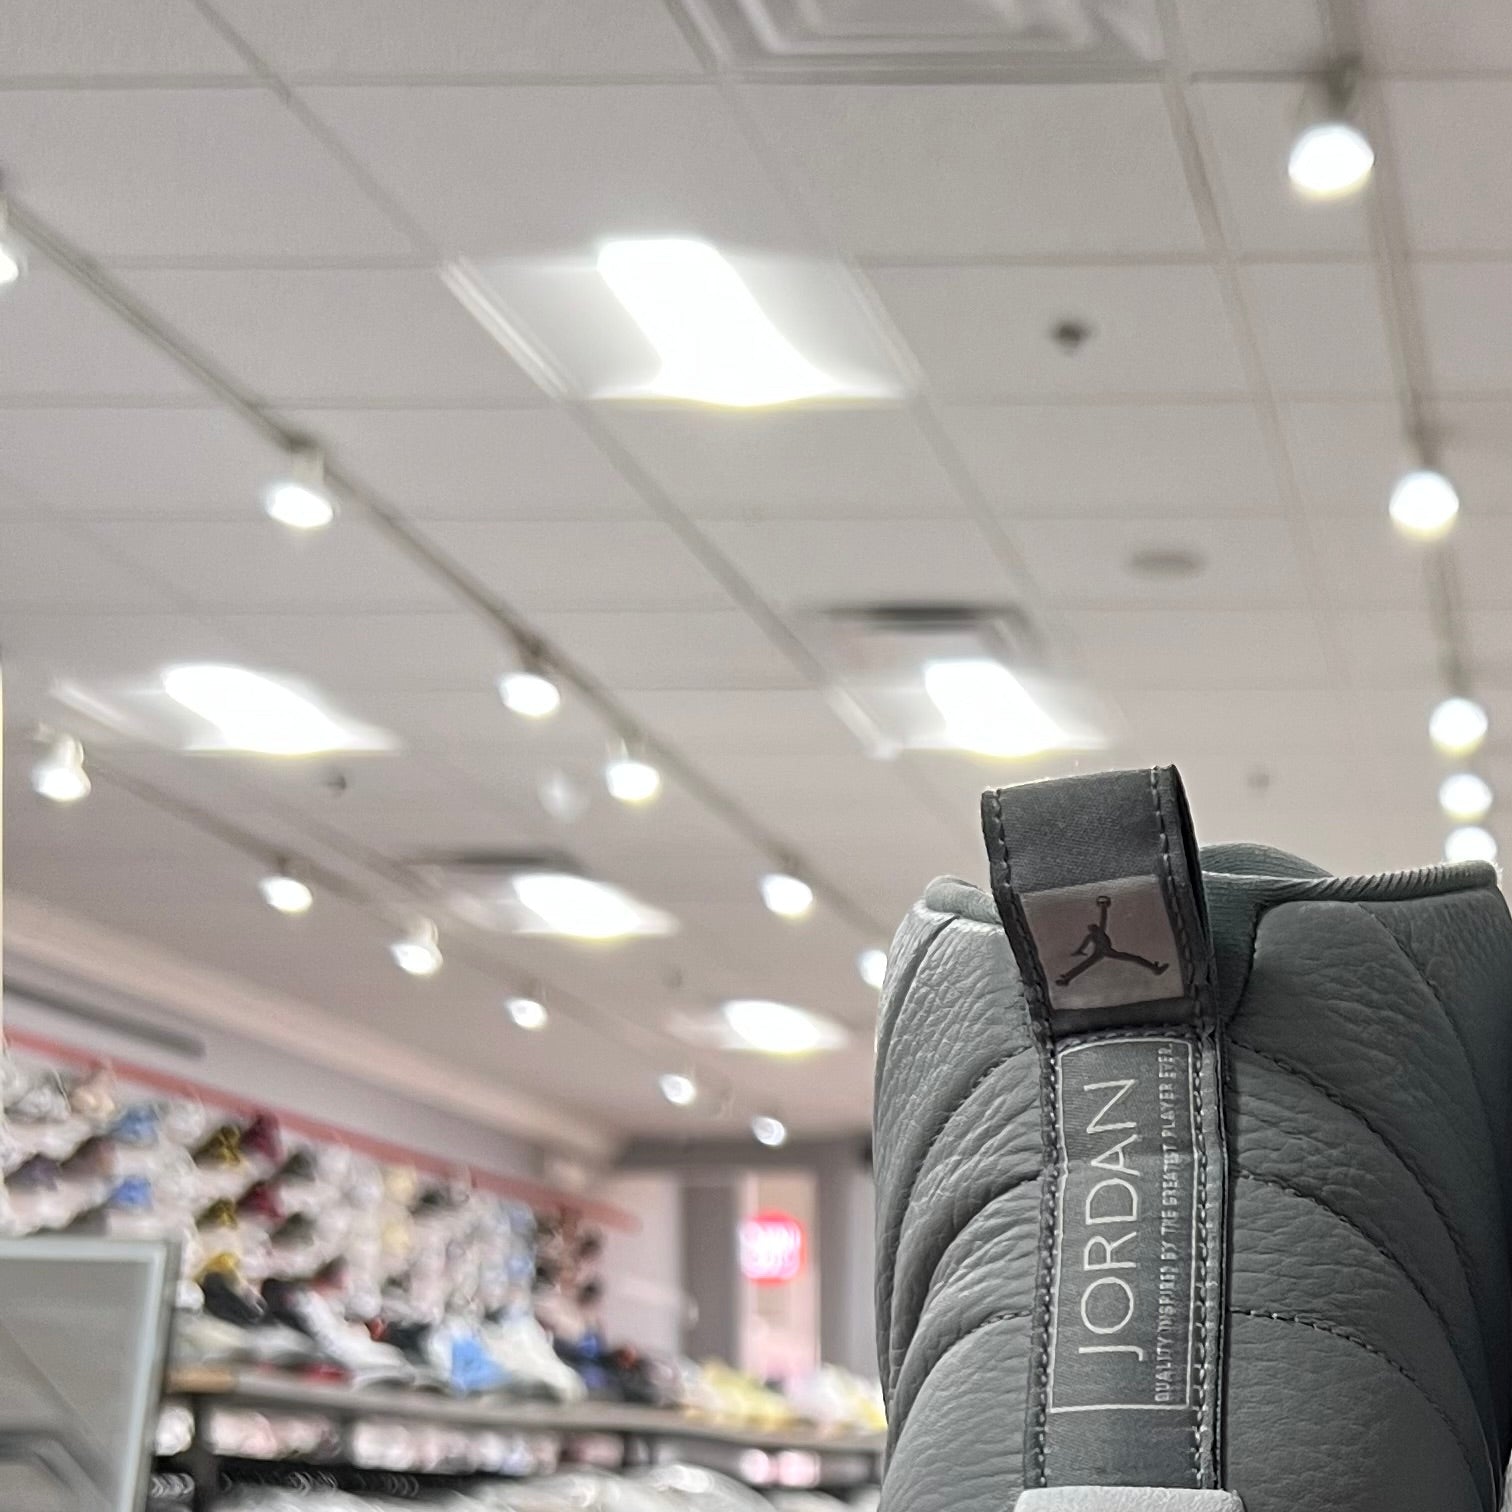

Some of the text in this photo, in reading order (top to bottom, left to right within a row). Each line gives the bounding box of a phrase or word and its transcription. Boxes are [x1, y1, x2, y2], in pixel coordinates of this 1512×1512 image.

[1159, 1083, 1177, 1138] PLAYER
[1161, 1143, 1179, 1206] GREATEST
[1078, 1078, 1144, 1361] JORDAN
[1161, 1211, 1178, 1236] THE
[1160, 1240, 1177, 1260] BY
[1154, 1336, 1173, 1402] QUALITY
